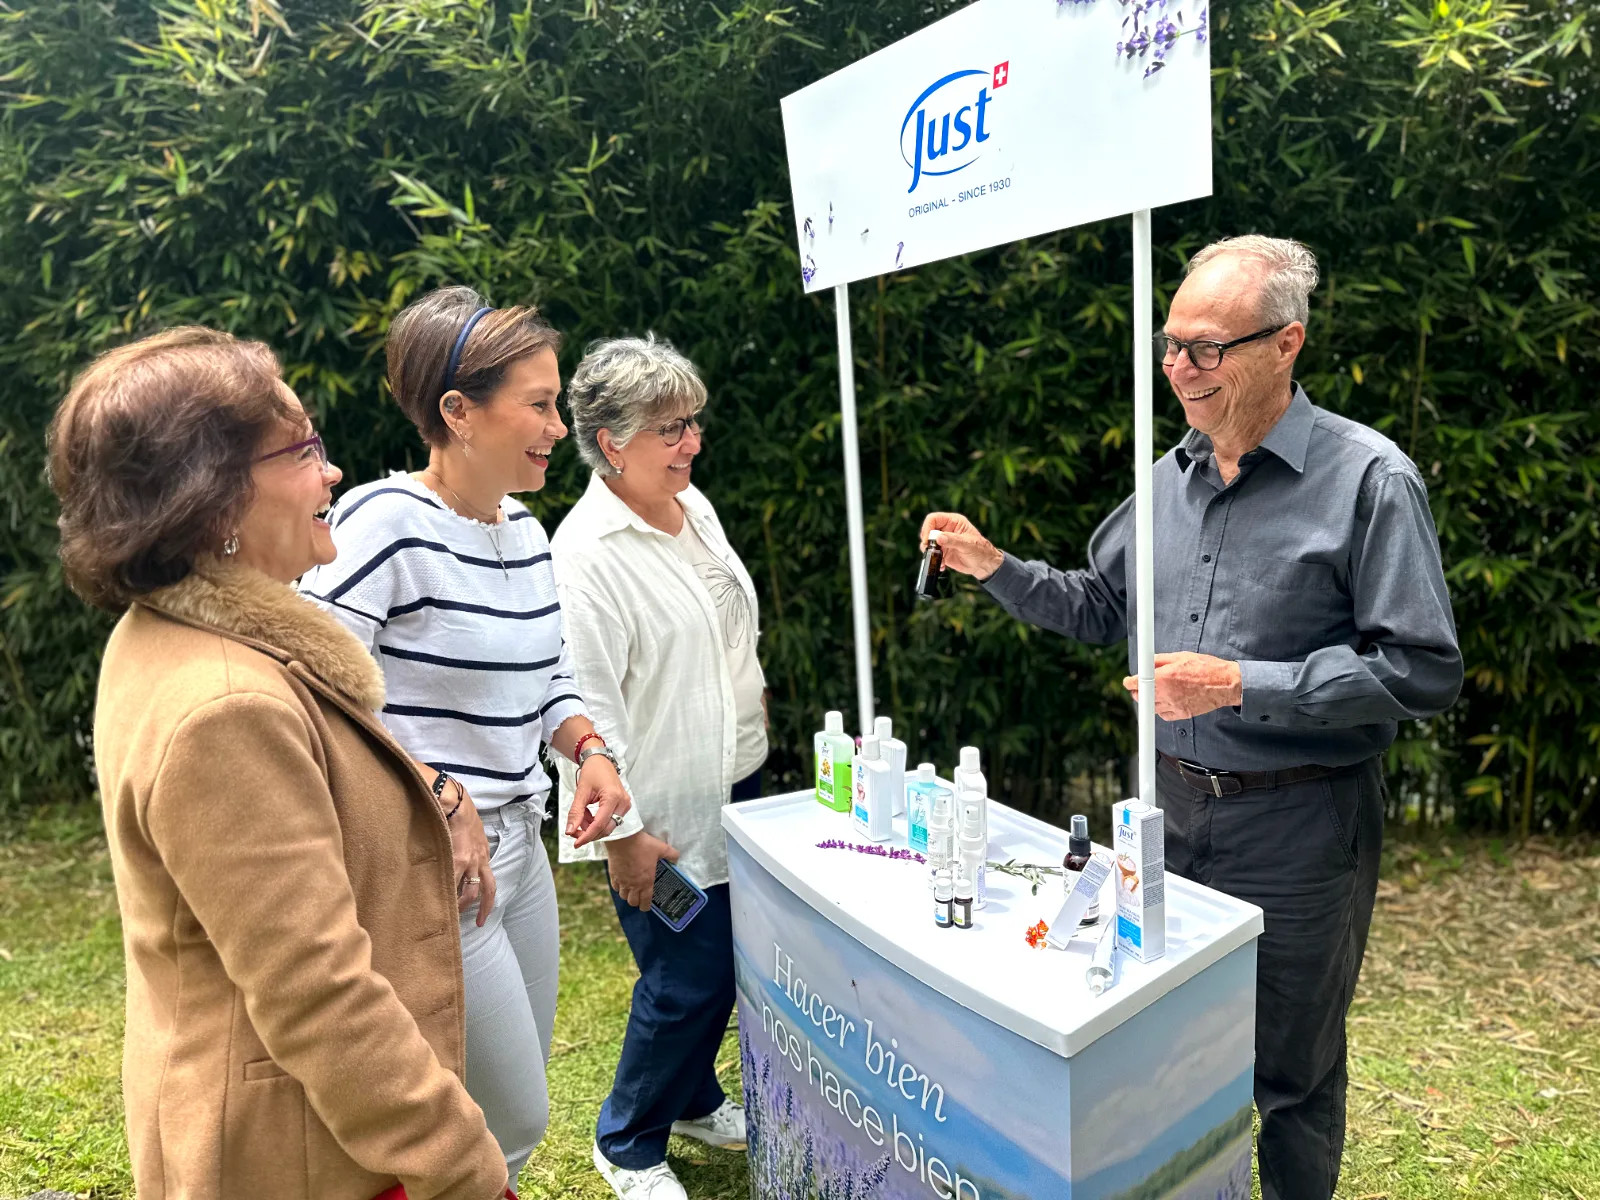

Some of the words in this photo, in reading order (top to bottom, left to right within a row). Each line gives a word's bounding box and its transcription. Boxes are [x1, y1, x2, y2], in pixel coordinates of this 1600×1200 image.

[908, 87, 993, 193] Just
[908, 198, 949, 218] ORIGINAL
[958, 184, 987, 203] SINCE
[988, 177, 1012, 193] 1930
[762, 1001, 803, 1073] nos
[807, 1040, 885, 1146] hace
[773, 941, 855, 1049] Hacer
[864, 1018, 947, 1123] bien
